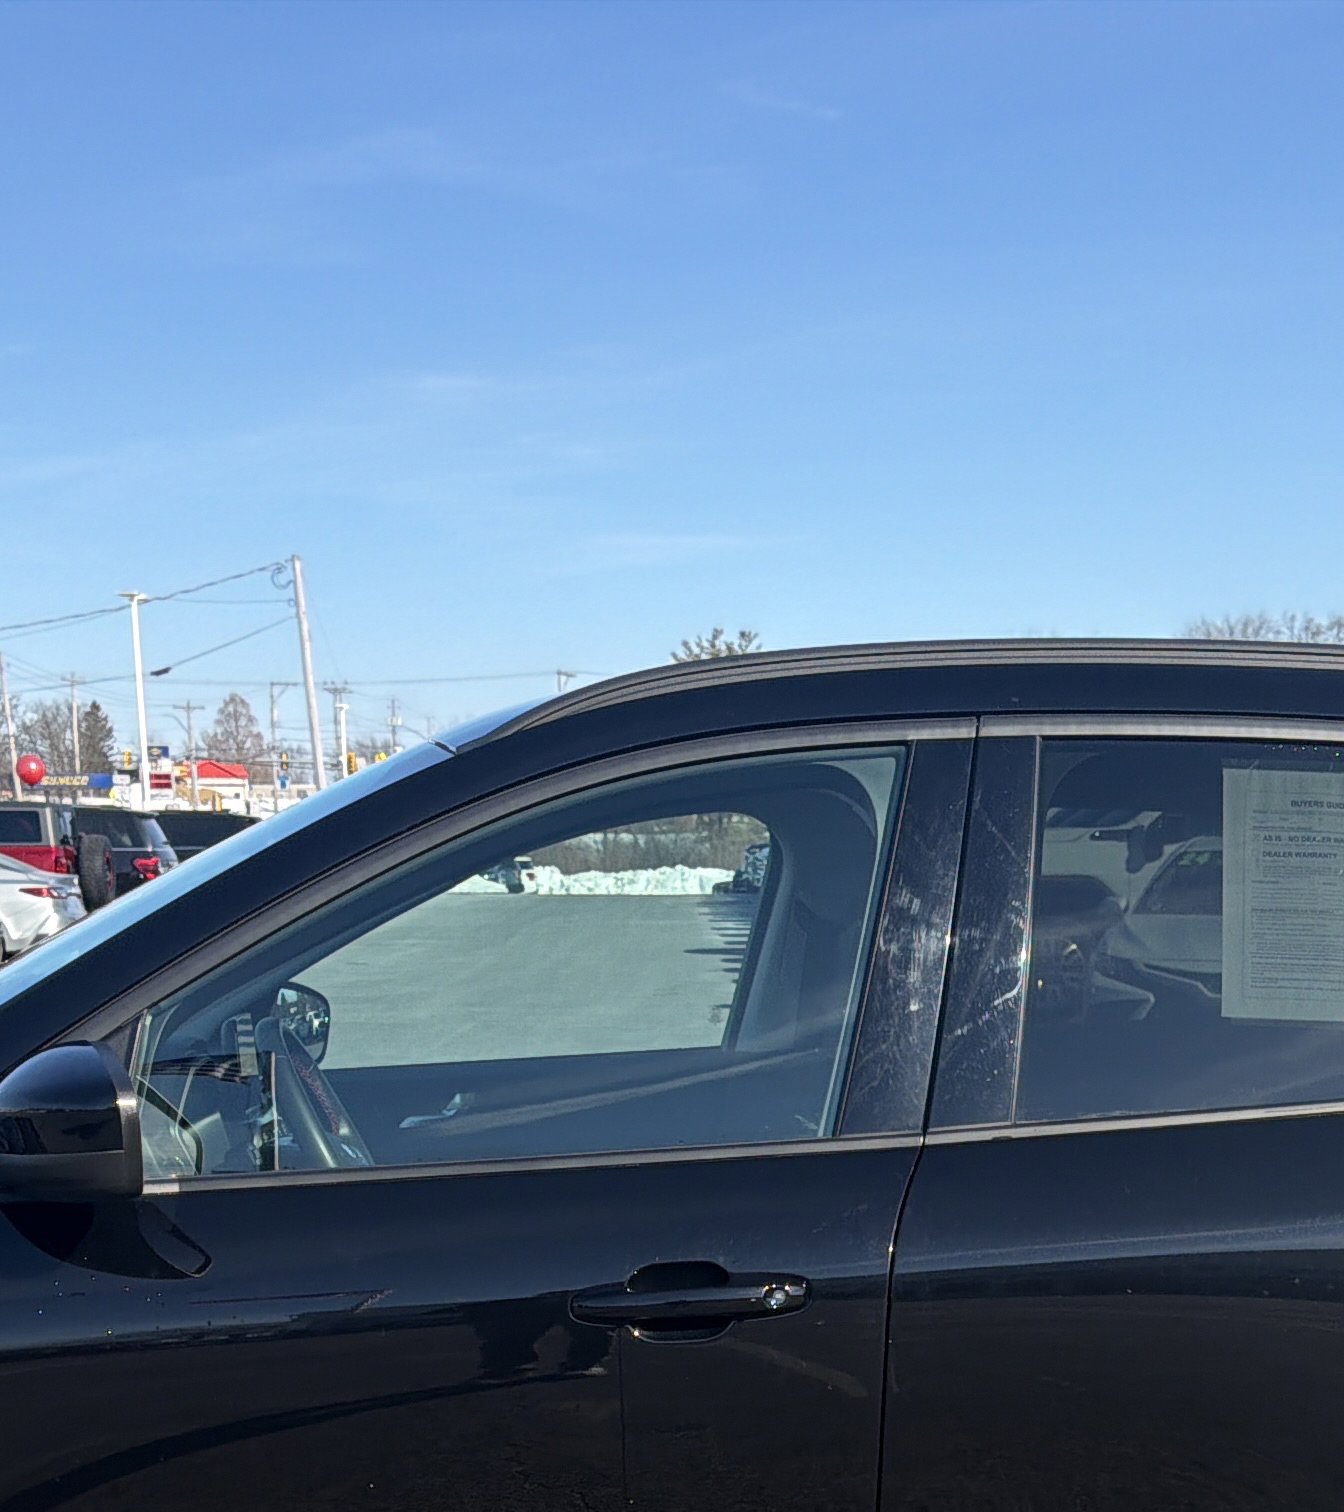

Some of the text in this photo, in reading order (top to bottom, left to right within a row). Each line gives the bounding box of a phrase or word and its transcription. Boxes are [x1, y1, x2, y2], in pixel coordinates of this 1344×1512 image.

[1290, 799, 1325, 809] BUYERS
[1262, 850, 1338, 860] DEALER WARRANTY
